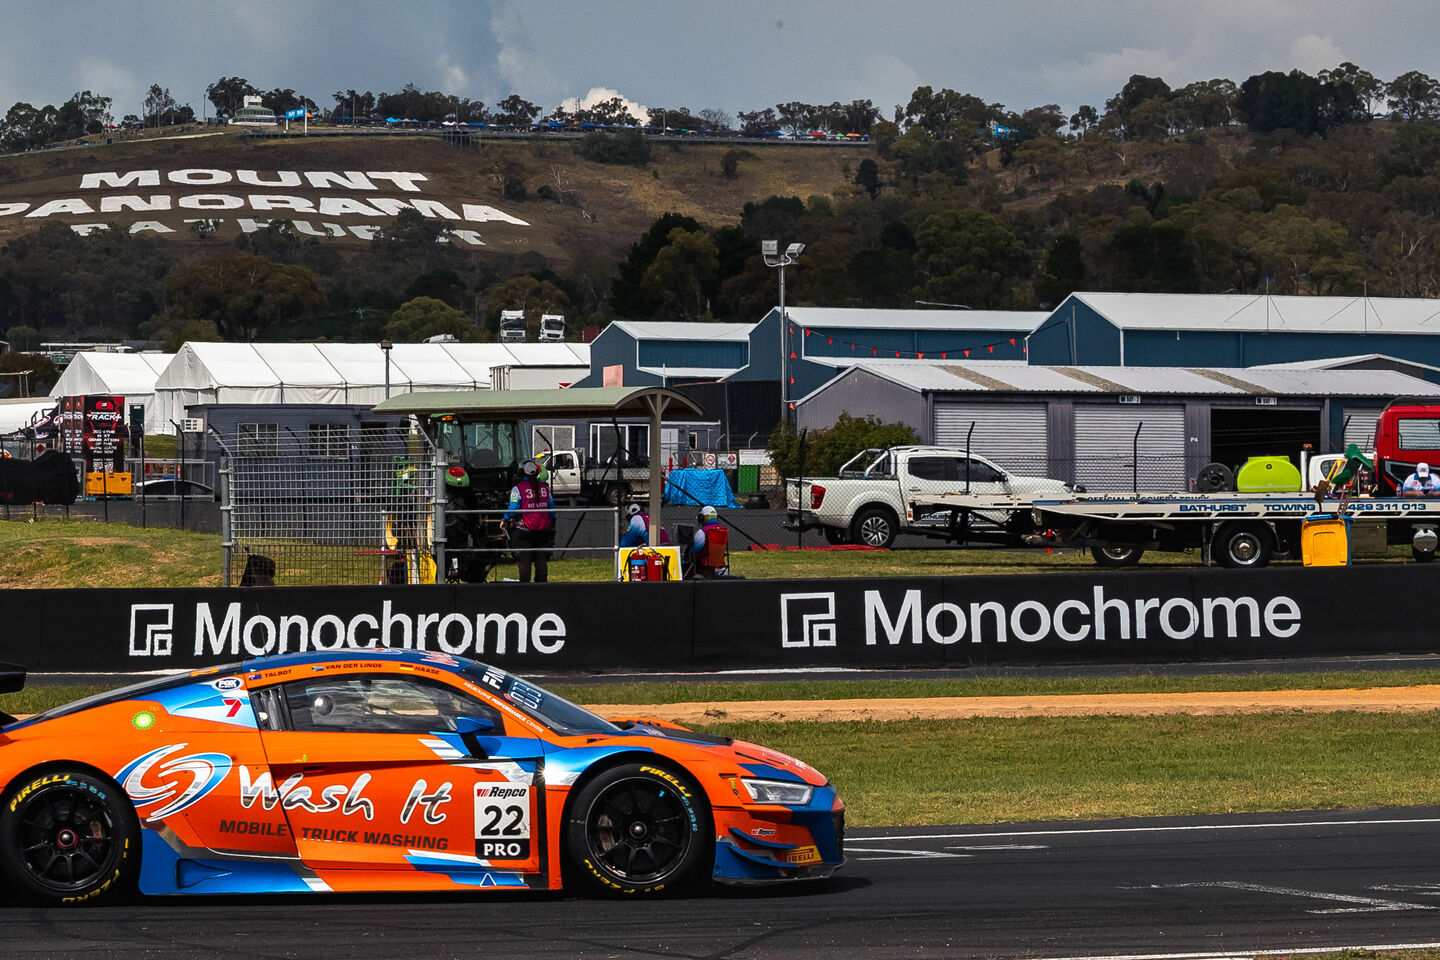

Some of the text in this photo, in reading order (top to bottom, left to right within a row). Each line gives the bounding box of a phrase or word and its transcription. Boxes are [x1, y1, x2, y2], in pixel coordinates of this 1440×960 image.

[80, 169, 428, 192] MOUNT
[1179, 504, 1247, 512] BATHURST
[1375, 503, 1400, 511] 311
[1401, 503, 1427, 511] 013
[193, 599, 567, 656] Monochrome
[864, 585, 1302, 646] Monochrome
[264, 669, 292, 678] TALBOT
[414, 665, 440, 676] HAASE
[9, 774, 72, 813] PIRELLI
[239, 763, 453, 826] Wash It
[488, 786, 527, 800] Repco
[639, 765, 693, 798] PIRELLI
[219, 819, 449, 851] MOBILE TRUCK WASHING
[480, 804, 525, 837] 22
[483, 842, 522, 857] PRO
